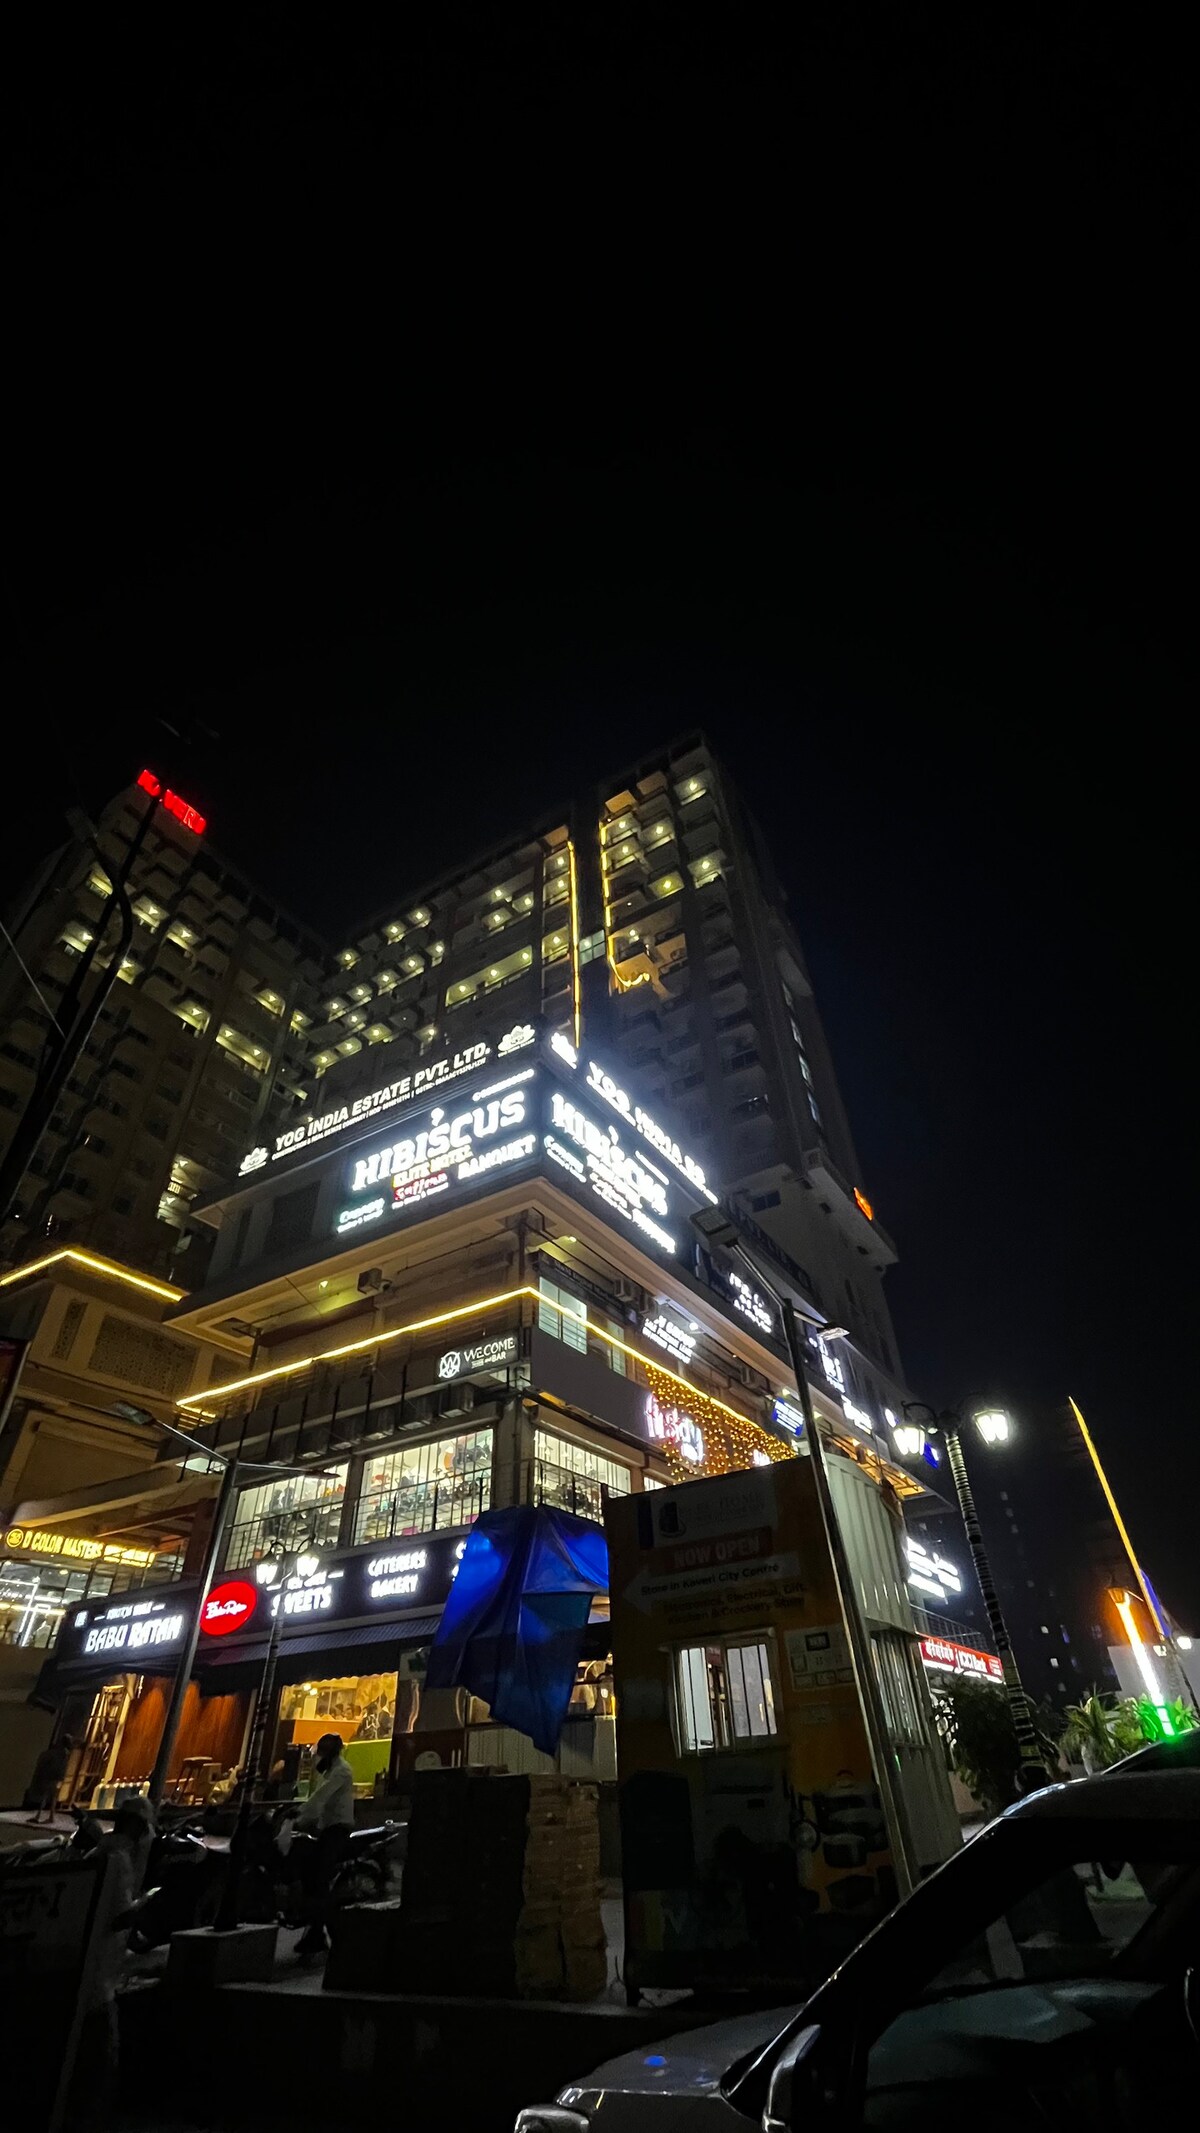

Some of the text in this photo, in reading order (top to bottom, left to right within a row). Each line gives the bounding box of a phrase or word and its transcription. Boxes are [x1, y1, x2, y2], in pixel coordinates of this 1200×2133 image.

[275, 1126, 305, 1151] YOG
[307, 1108, 349, 1137] INDIA
[352, 1081, 411, 1115] ESTATE
[414, 1060, 449, 1088] PVT.
[453, 1042, 491, 1070] LTD.
[352, 1090, 525, 1191] HIBISCUS
[674, 1536, 760, 1569] NOW OPEN
[670, 1581, 680, 1590] in
[683, 1575, 716, 1588] Kaveri
[718, 1572, 739, 1583] City
[85, 1622, 126, 1654] BABU
